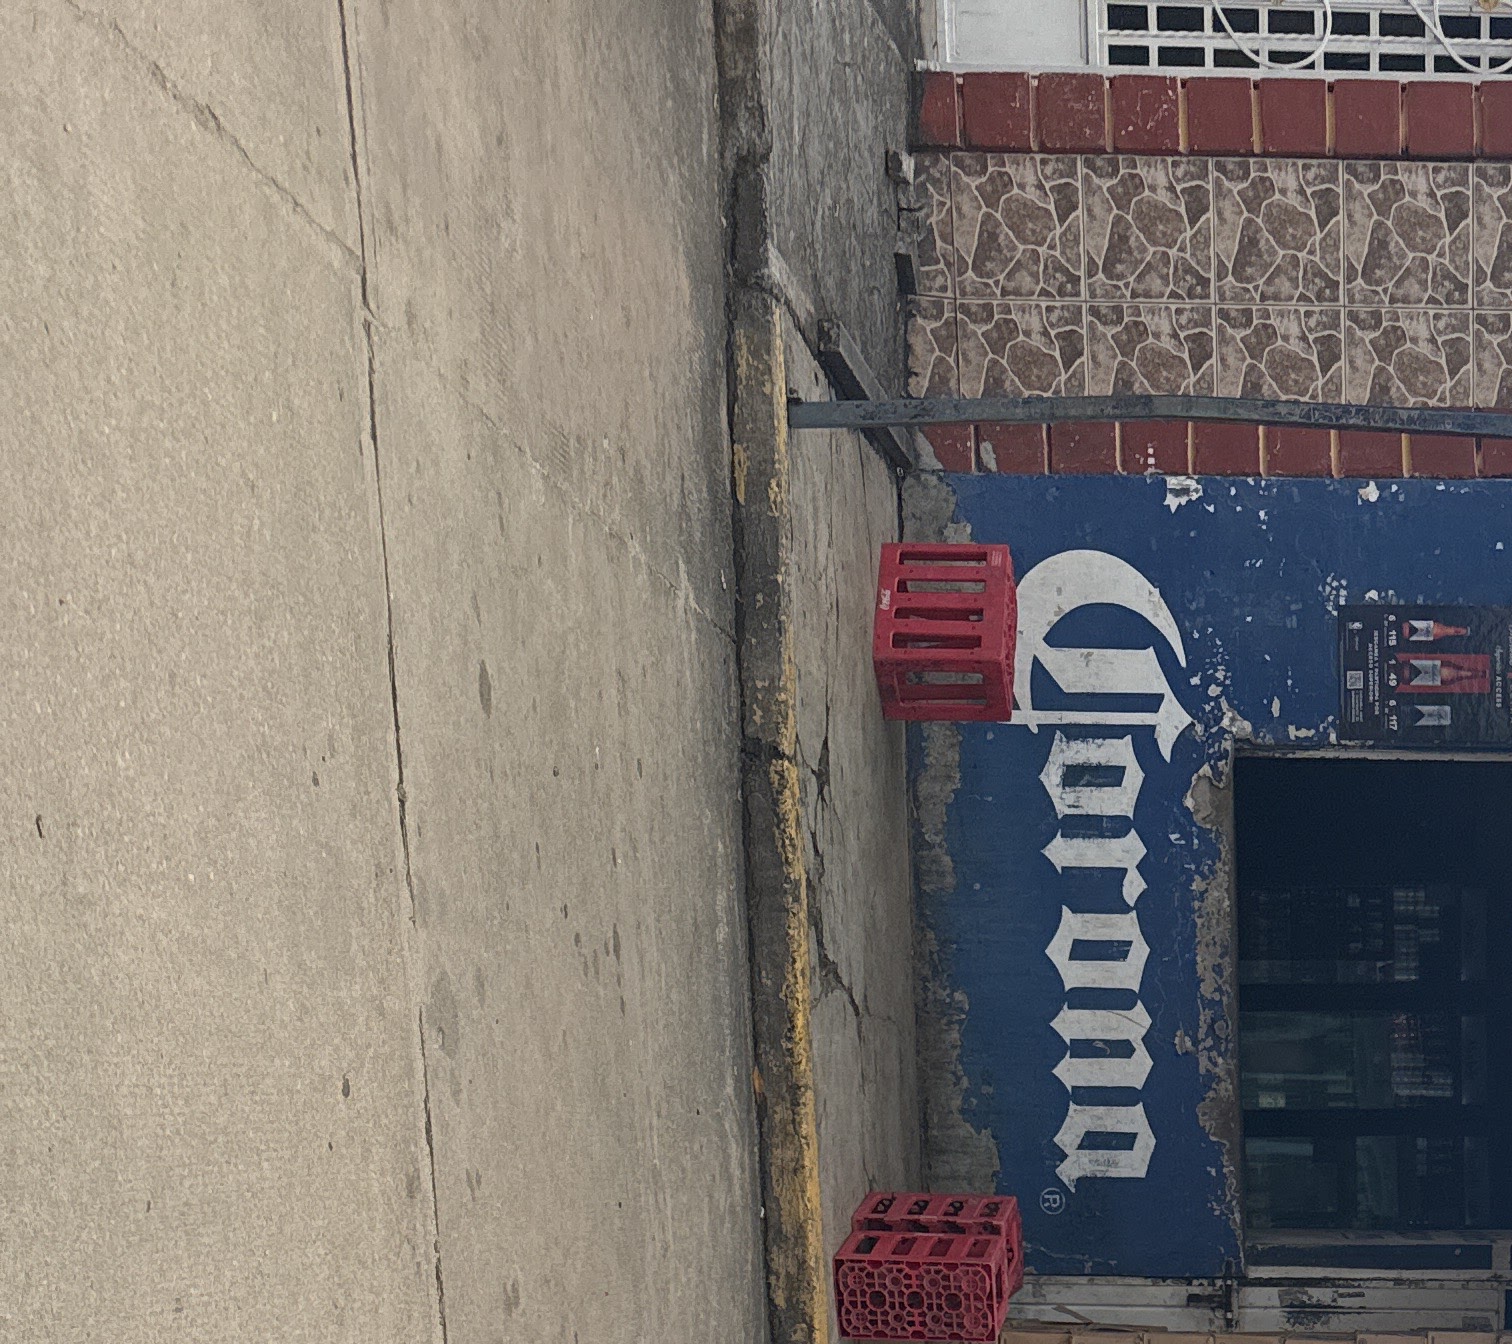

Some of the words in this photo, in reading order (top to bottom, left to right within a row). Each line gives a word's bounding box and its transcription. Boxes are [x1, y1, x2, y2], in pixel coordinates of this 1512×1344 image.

[1388, 614, 1396, 622] 6
[1388, 630, 1396, 646] 115
[1388, 672, 1398, 686] 49
[1389, 714, 1398, 730] 117
[998, 550, 1192, 1193] Corona
